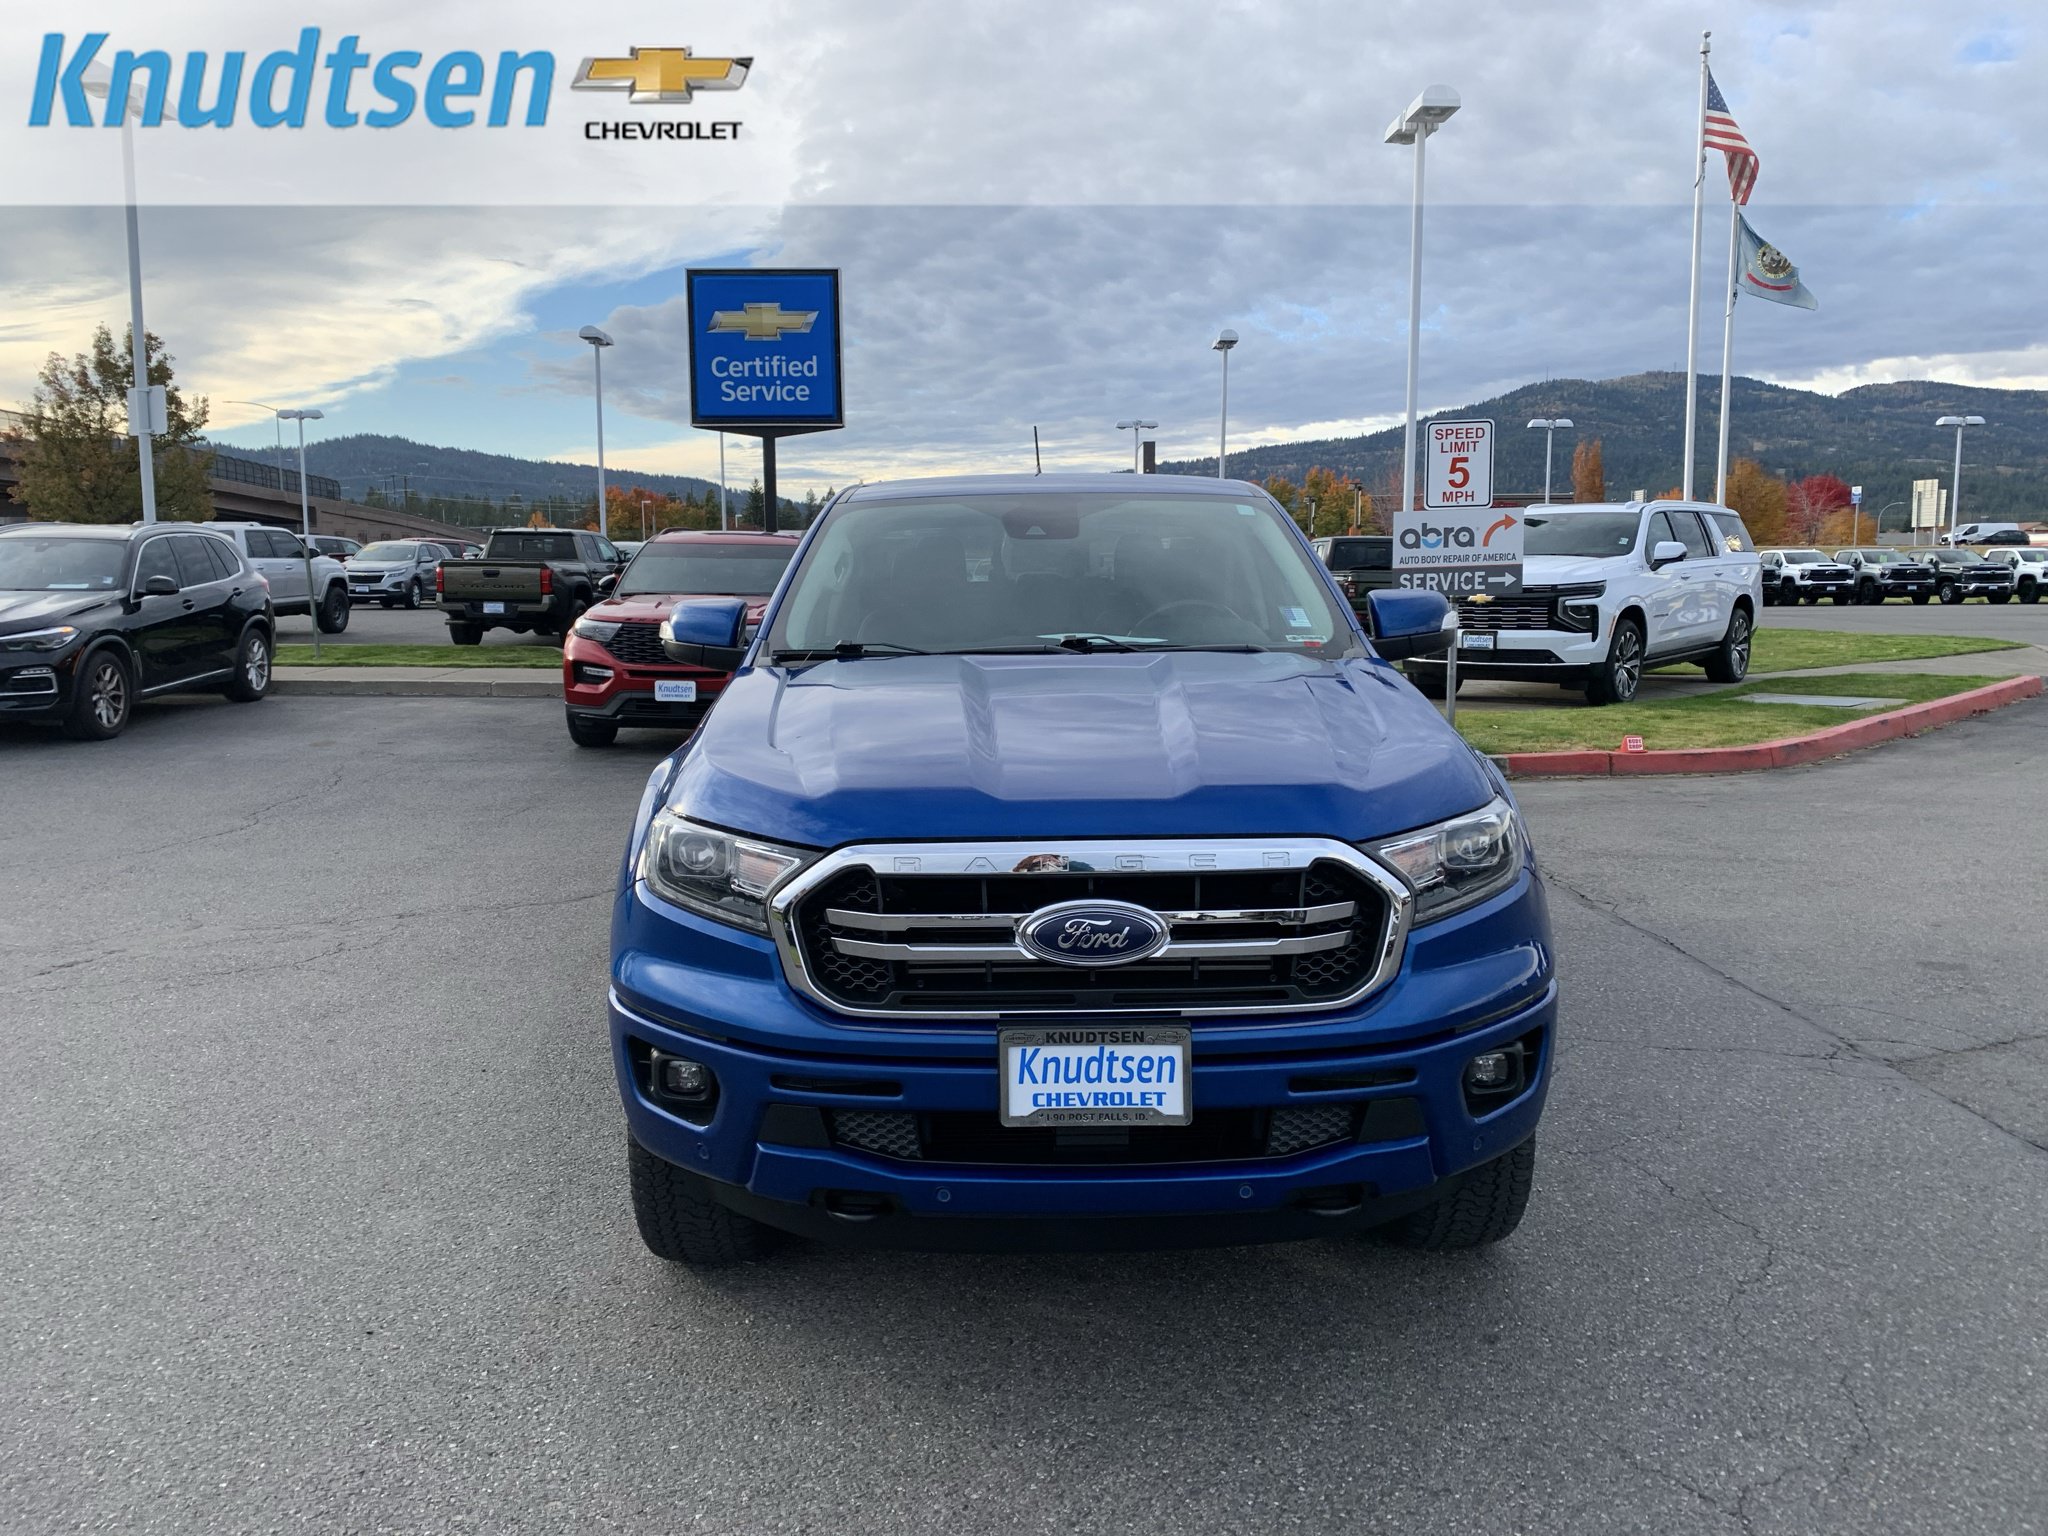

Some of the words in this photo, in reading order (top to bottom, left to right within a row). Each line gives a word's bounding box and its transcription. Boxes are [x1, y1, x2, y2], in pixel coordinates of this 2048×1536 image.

[711, 355, 818, 377] Certified
[721, 380, 810, 401] Service
[1434, 427, 1485, 440] SPEED
[1440, 441, 1479, 453] LIMIT
[1448, 456, 1470, 489] 5
[1442, 491, 1475, 503] MPH
[1399, 523, 1475, 550] abra
[1400, 555, 1420, 565] AUTO
[1421, 555, 1442, 564] BODY
[1443, 554, 1468, 563] REPAIR
[1472, 553, 1482, 562] OF
[1482, 552, 1517, 562] AMERICA
[1400, 571, 1486, 591] SERVICE
[658, 683, 693, 693] Knudtsen
[1057, 918, 1130, 948] Ford
[1046, 1031, 1145, 1044] KNUDTSEN
[1018, 1046, 1176, 1085] Knudtsen
[1032, 1091, 1167, 1107] CHEVROLET
[1068, 1113, 1095, 1121] POST
